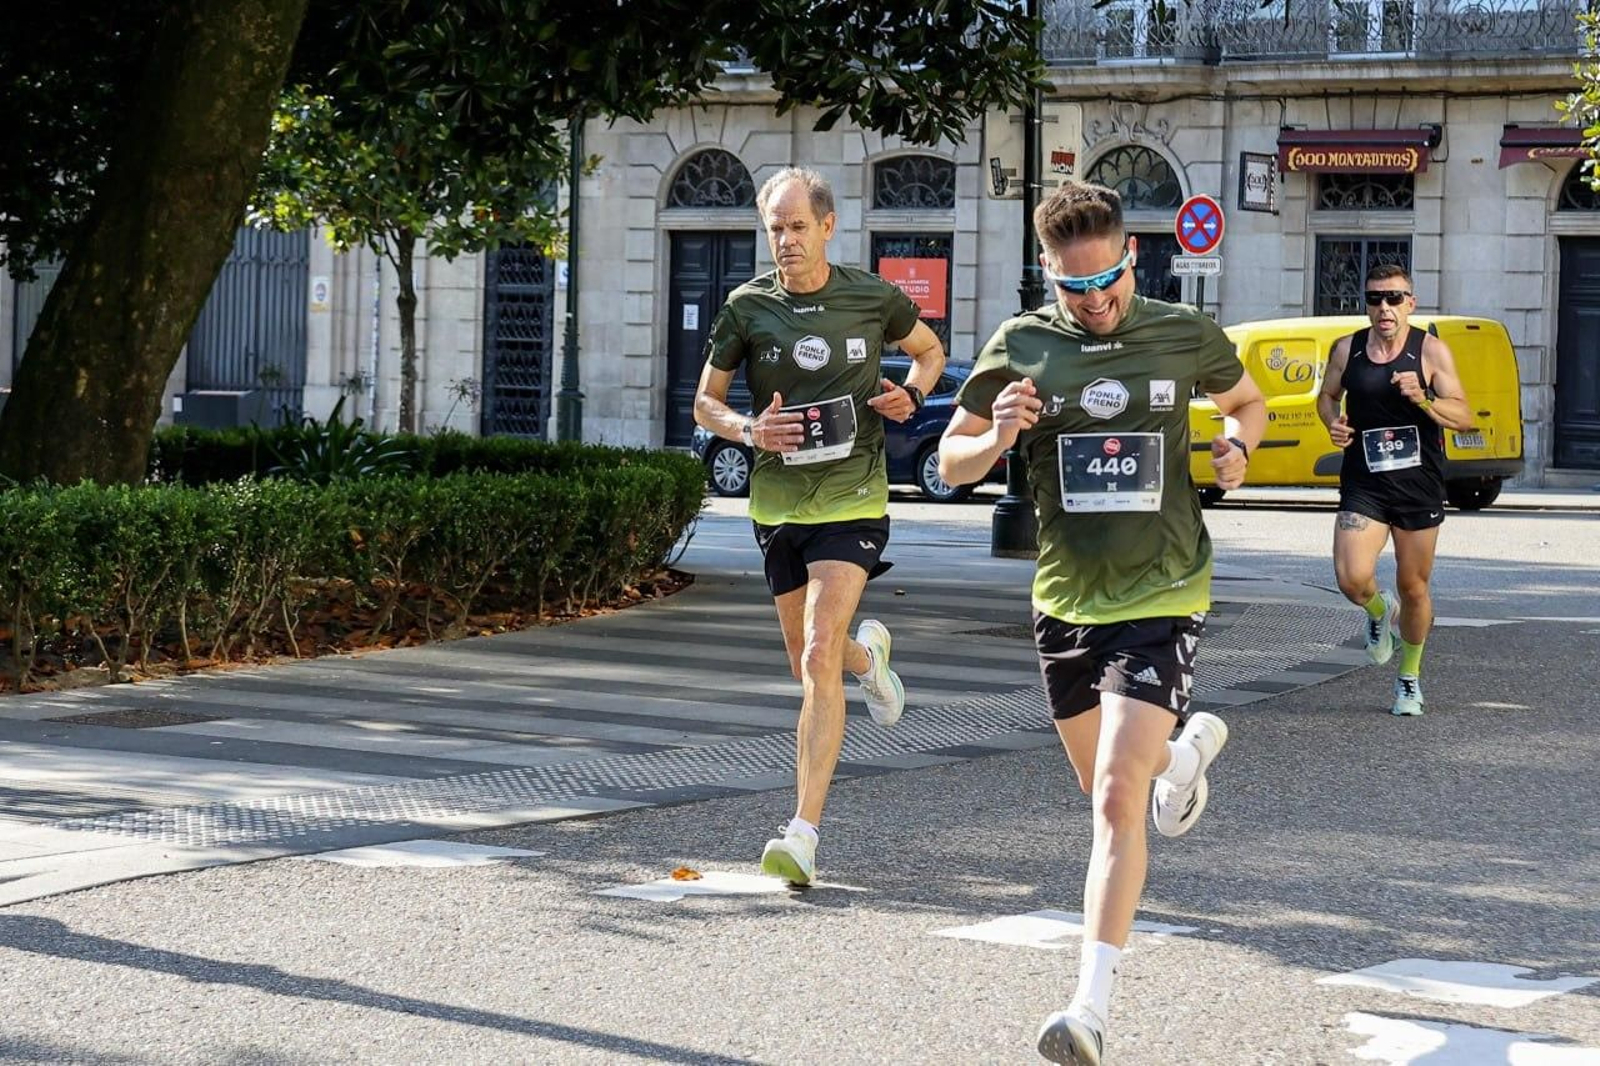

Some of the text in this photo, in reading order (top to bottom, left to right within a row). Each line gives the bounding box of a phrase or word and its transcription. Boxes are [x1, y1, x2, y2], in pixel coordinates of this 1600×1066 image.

[800, 344, 825, 355] PONLE
[1081, 344, 1112, 352] luanvi
[798, 351, 824, 362] FRENO
[1089, 390, 1122, 401] PONLE
[1153, 393, 1171, 403] AXA
[1087, 397, 1121, 408] FRENO
[809, 422, 824, 437] 2
[1376, 439, 1404, 452] 139
[1086, 456, 1137, 476] 440
